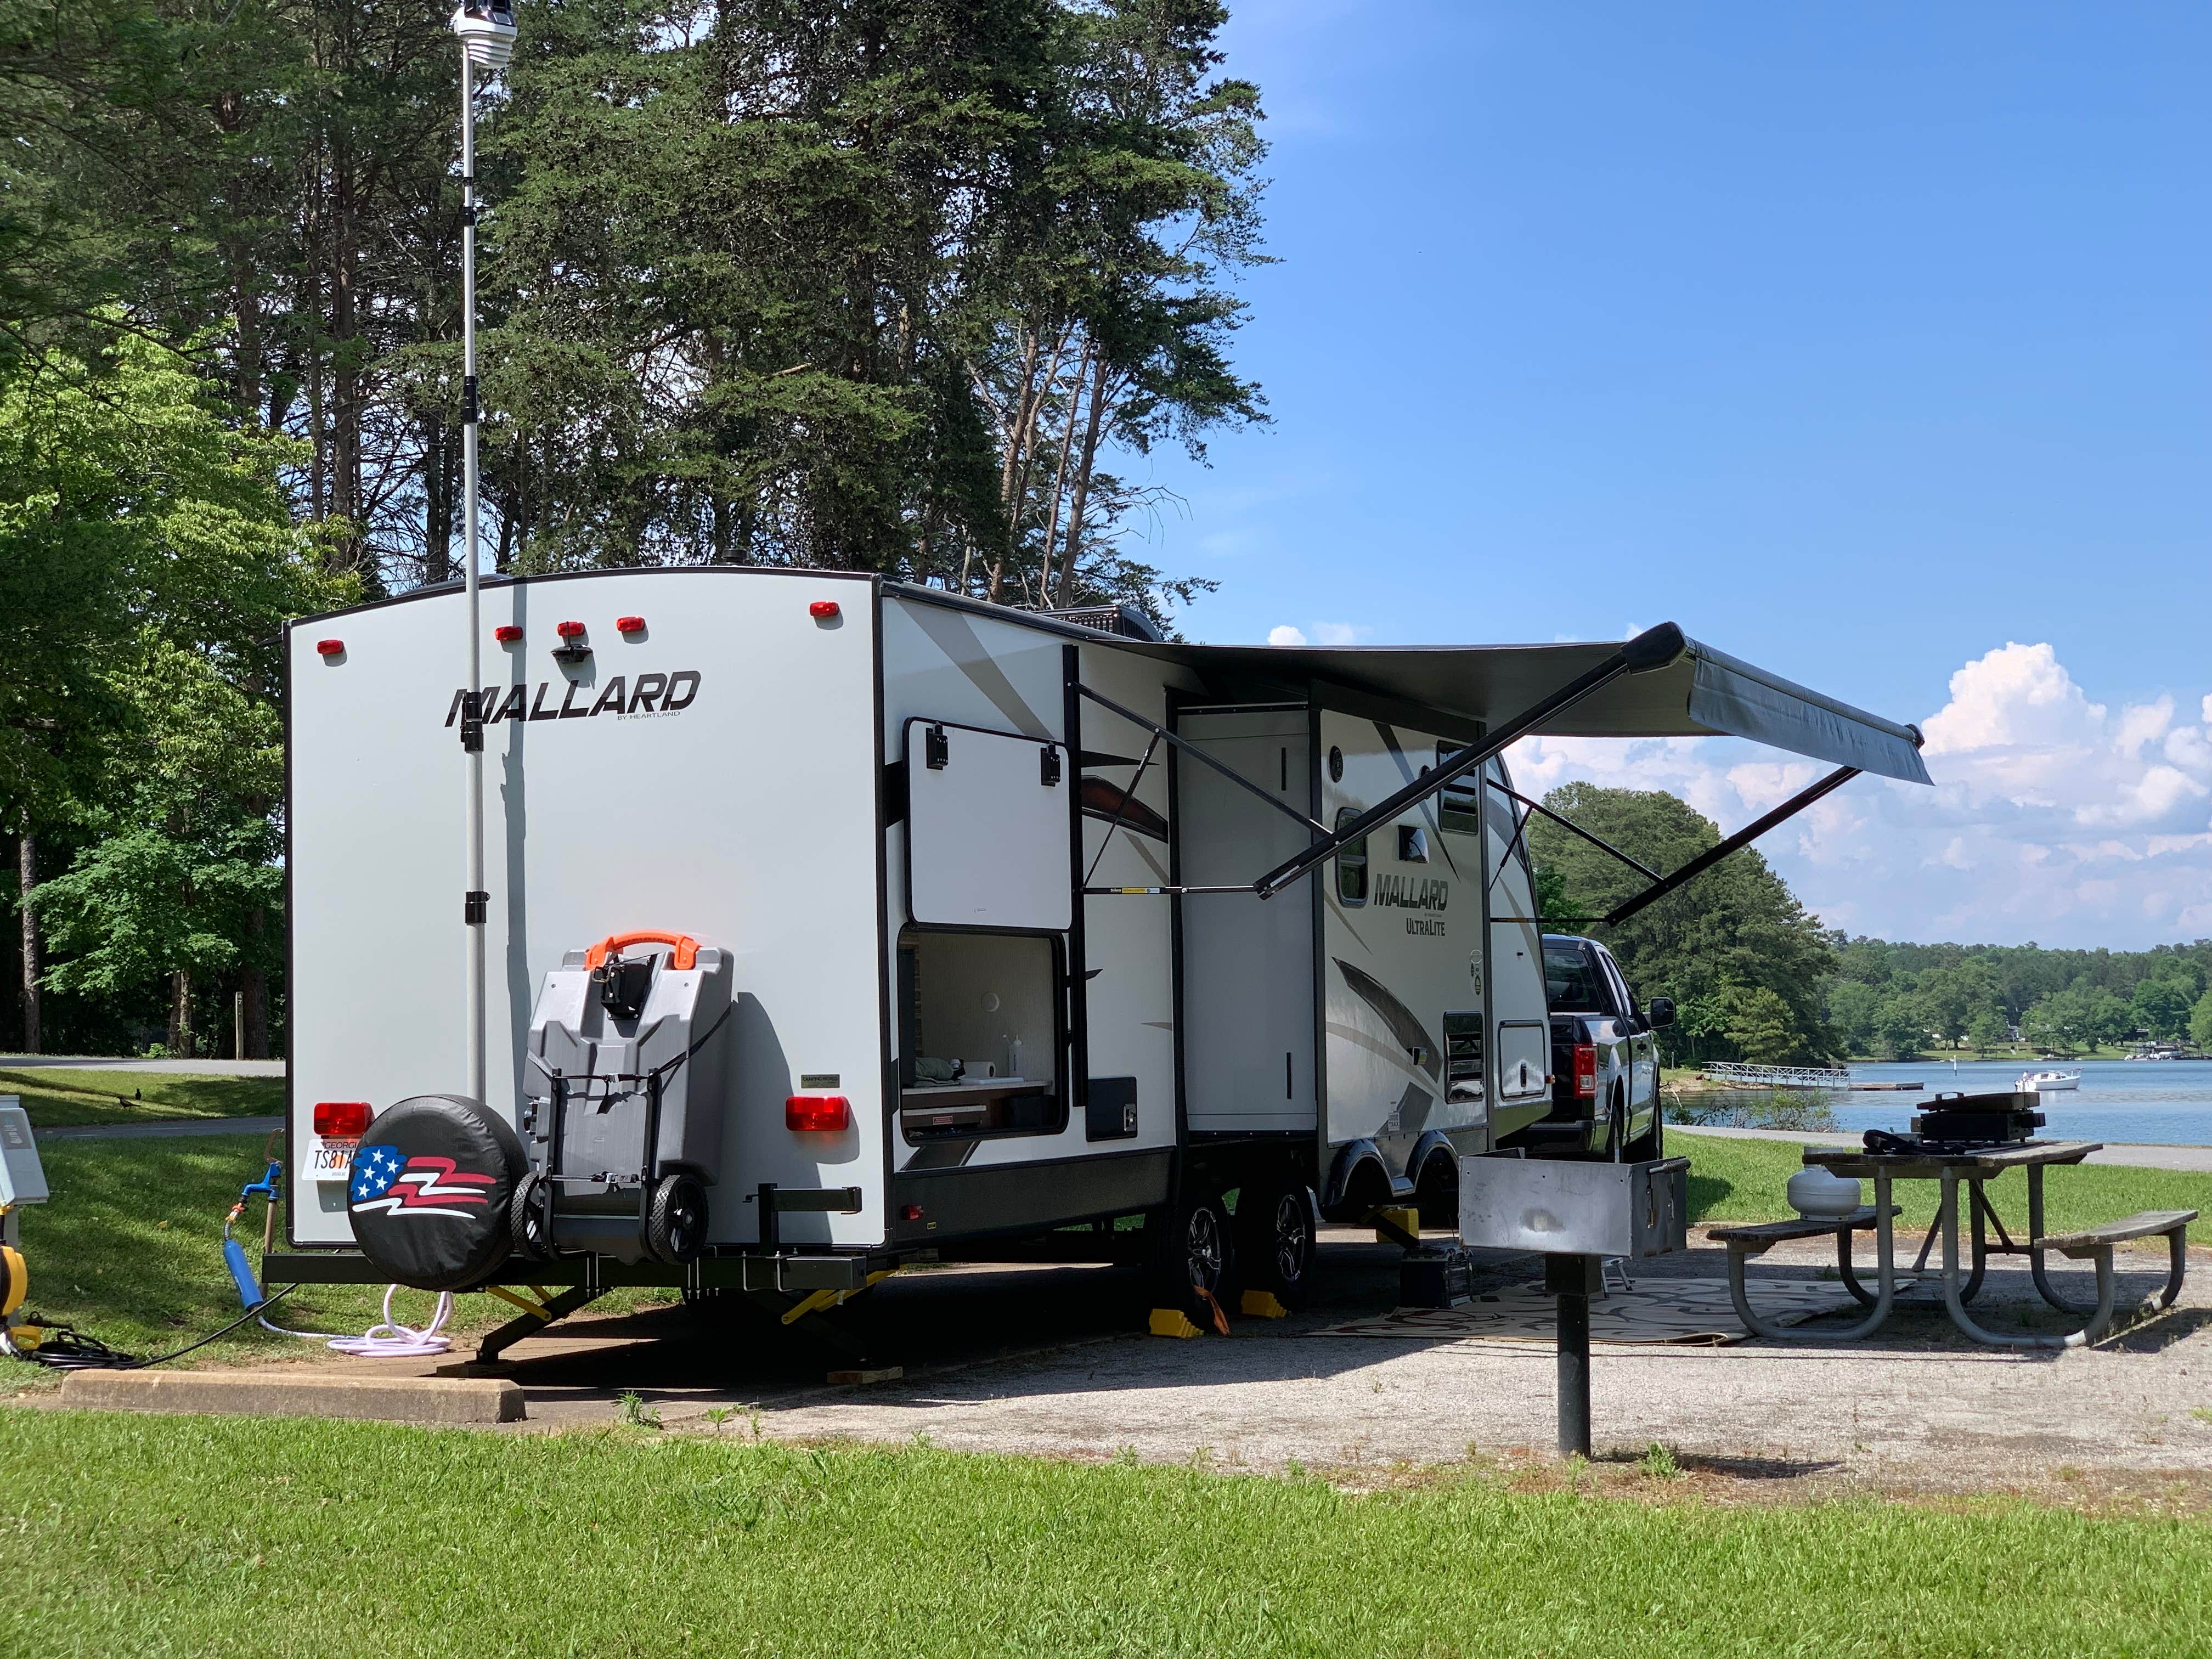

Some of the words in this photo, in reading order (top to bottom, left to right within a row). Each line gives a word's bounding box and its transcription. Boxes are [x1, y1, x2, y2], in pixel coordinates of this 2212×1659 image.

[444, 670, 701, 727] MALLARD
[630, 711, 680, 719] HEARTLAND
[1374, 873, 1448, 911] MALLARD
[314, 1150, 353, 1169] TS81A
